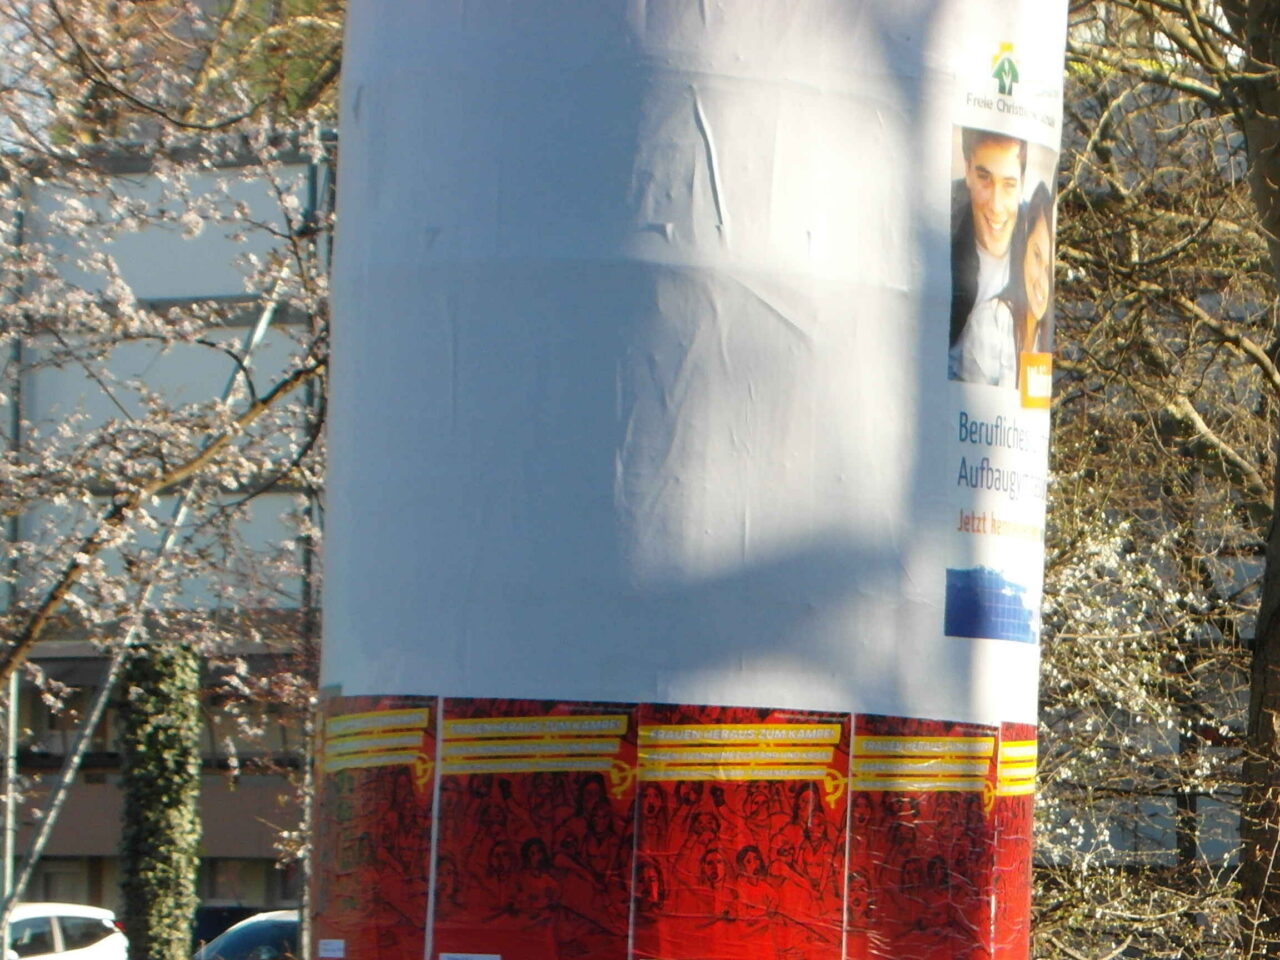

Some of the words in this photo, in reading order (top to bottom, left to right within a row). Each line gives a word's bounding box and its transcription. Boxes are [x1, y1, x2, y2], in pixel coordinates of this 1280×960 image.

[966, 92, 993, 111] Freie
[957, 507, 986, 534] Jetzt
[649, 729, 701, 741] FRAUEN
[703, 729, 756, 740] HERAUS
[758, 728, 786, 740] ZUM
[787, 728, 836, 740] KAMPF!
